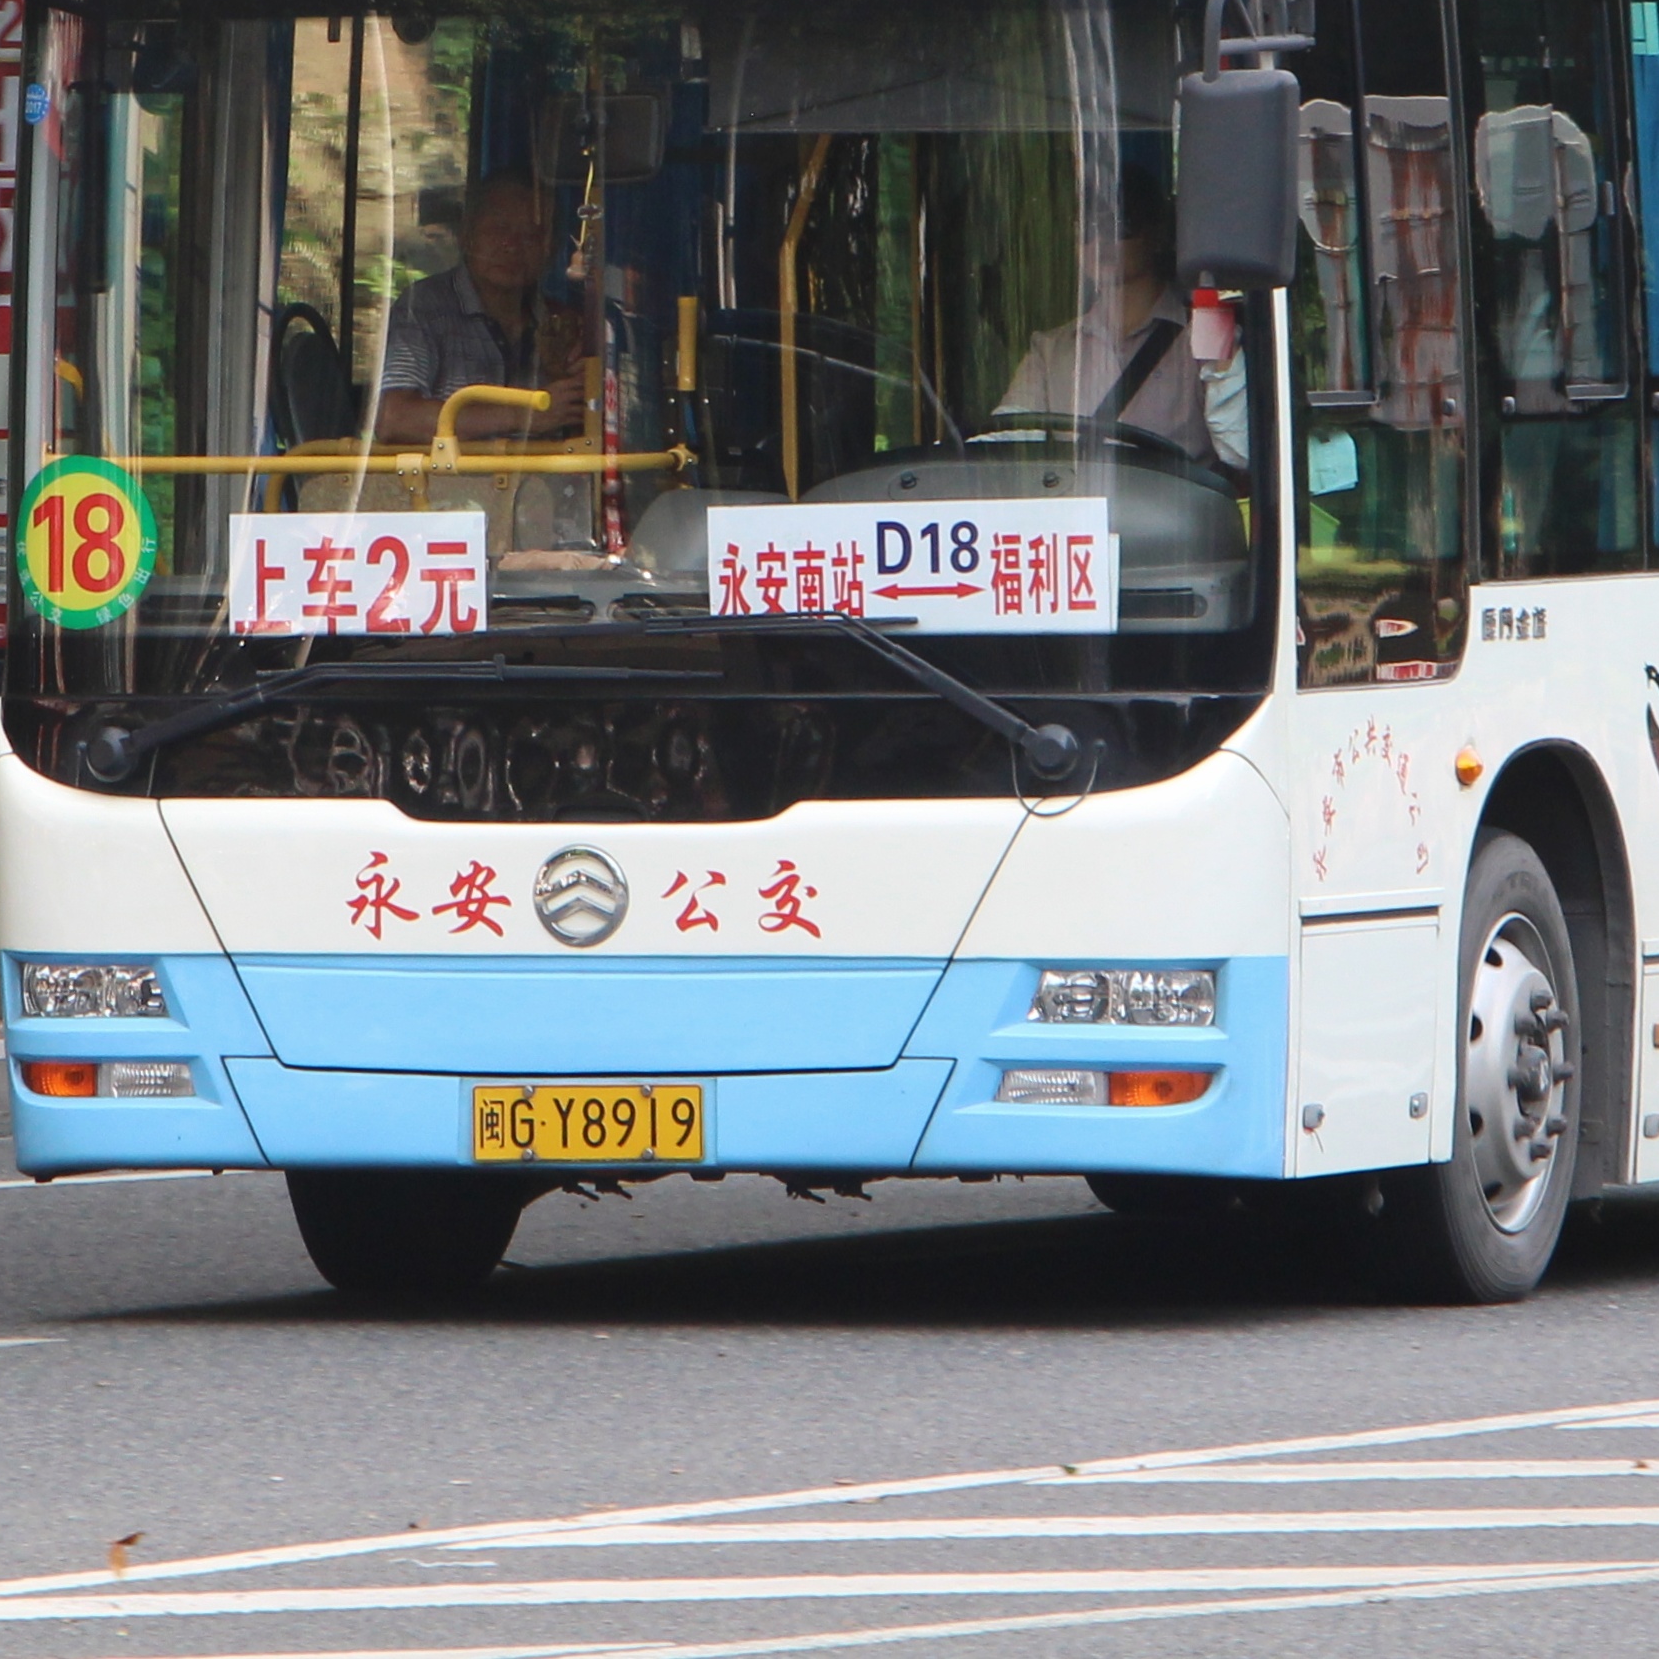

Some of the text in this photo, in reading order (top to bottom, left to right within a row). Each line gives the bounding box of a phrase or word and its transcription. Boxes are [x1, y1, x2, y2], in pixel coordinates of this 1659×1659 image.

[32, 493, 125, 594] 18
[234, 535, 478, 635] 上车2元
[718, 520, 1098, 619] 永安南站 D18 福利区
[345, 850, 823, 941] 永安 公交
